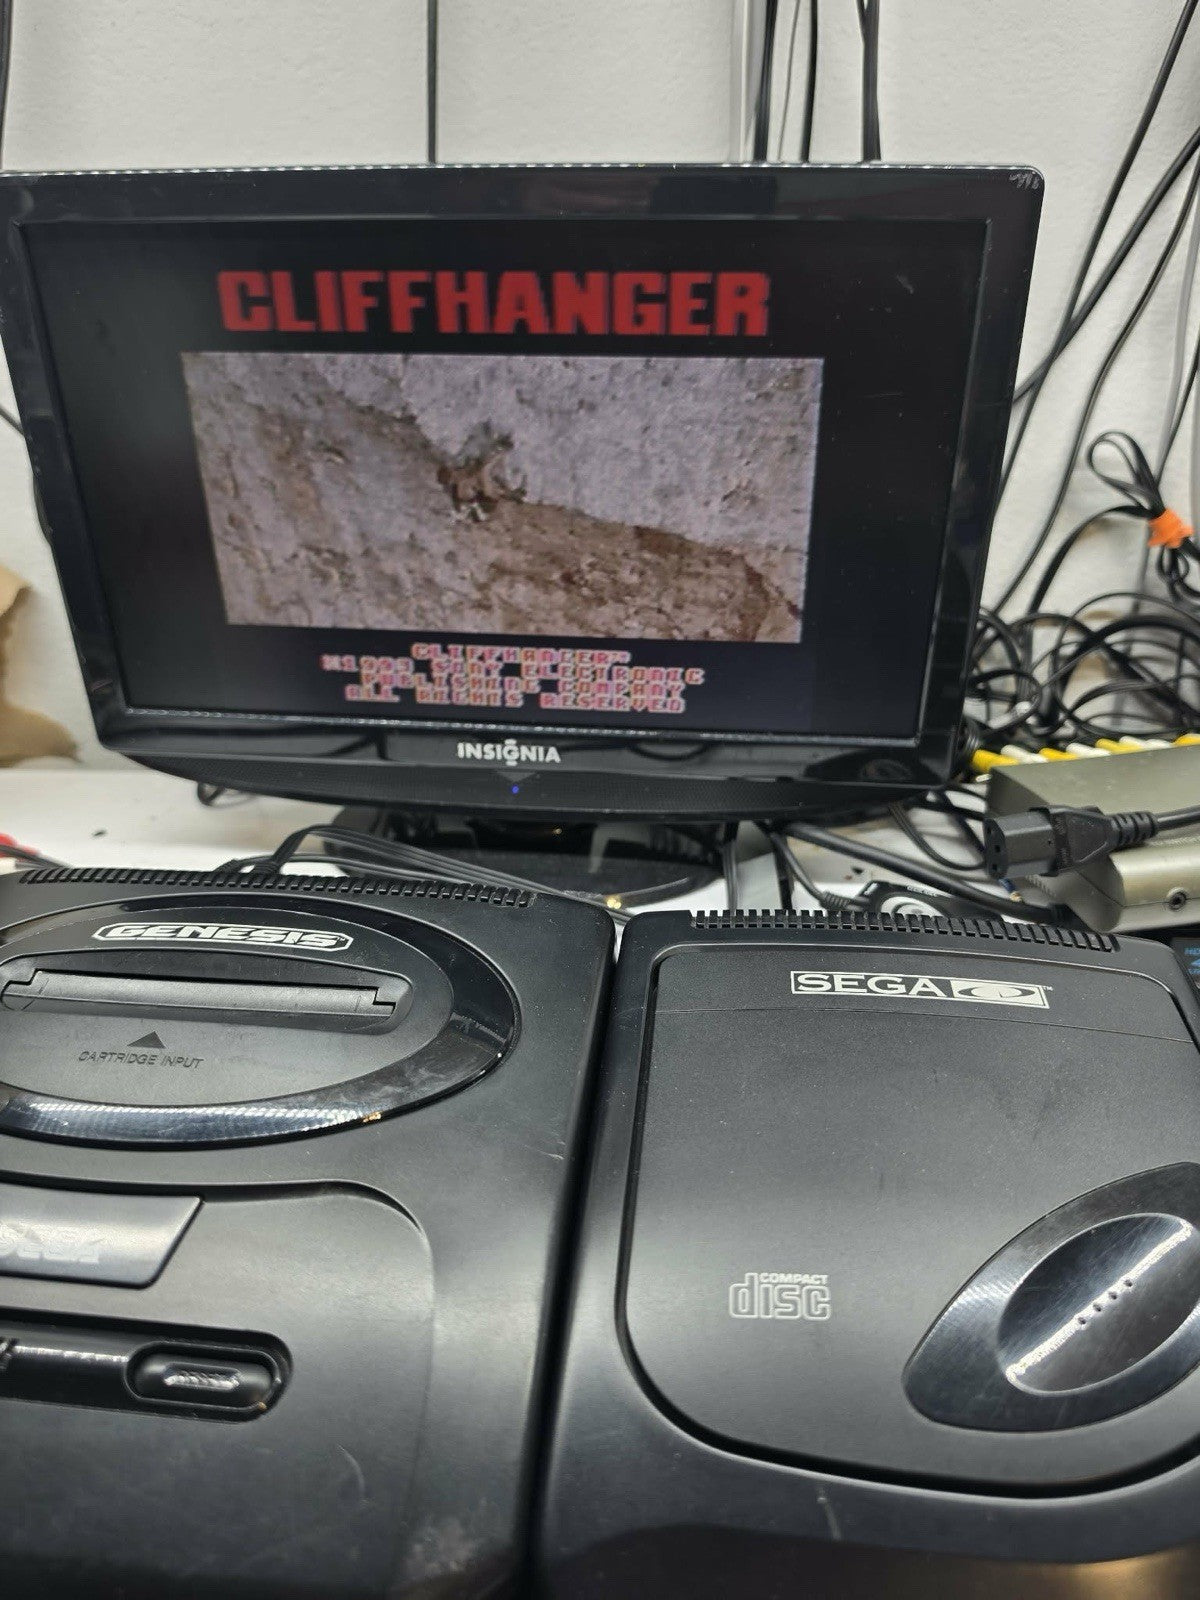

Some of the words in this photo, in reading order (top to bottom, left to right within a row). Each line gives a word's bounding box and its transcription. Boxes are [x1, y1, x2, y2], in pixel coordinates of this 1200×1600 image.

[217, 270, 770, 336] CLIFFHANGER
[539, 692, 686, 714] RESERVED
[457, 741, 561, 765] INSIGNIA
[106, 925, 339, 948] GENESIS
[797, 973, 948, 998] SEGA
[78, 1051, 157, 1066] CARTRIDGE
[161, 1055, 205, 1069] INPUT
[759, 1272, 829, 1285] COMPACT
[729, 1272, 832, 1320] disc
